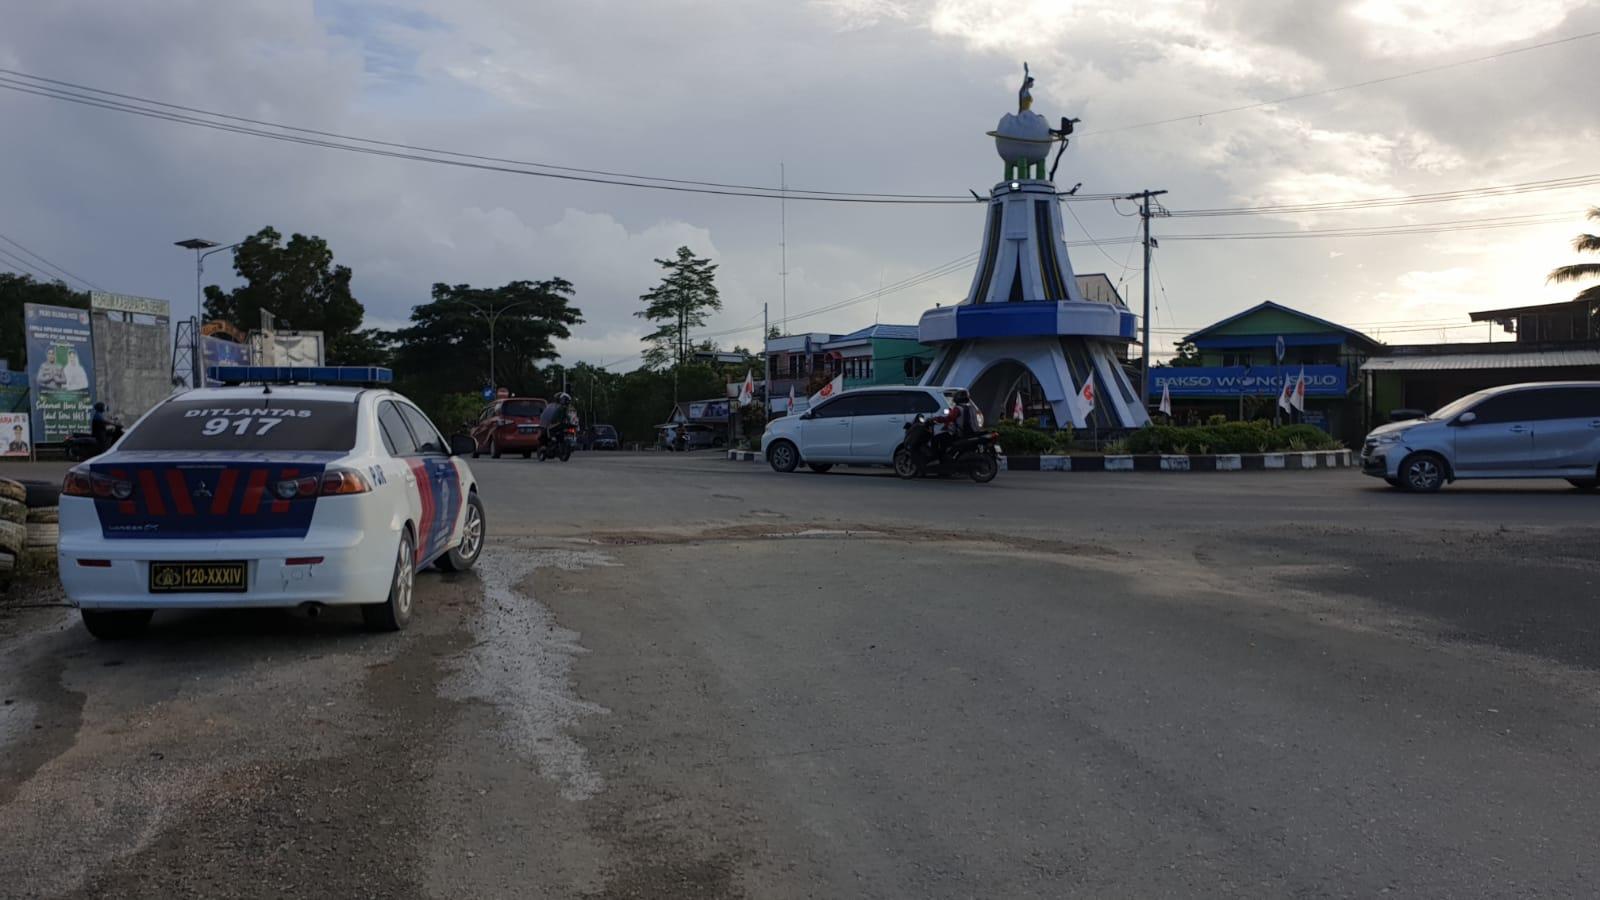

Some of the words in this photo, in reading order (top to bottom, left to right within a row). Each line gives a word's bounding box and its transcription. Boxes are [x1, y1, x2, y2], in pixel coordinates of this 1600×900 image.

[1155, 376, 1211, 386] BAKSO
[1290, 375, 1337, 386] SOLO
[184, 408, 313, 418] DITLANTAS
[202, 417, 282, 436] 917
